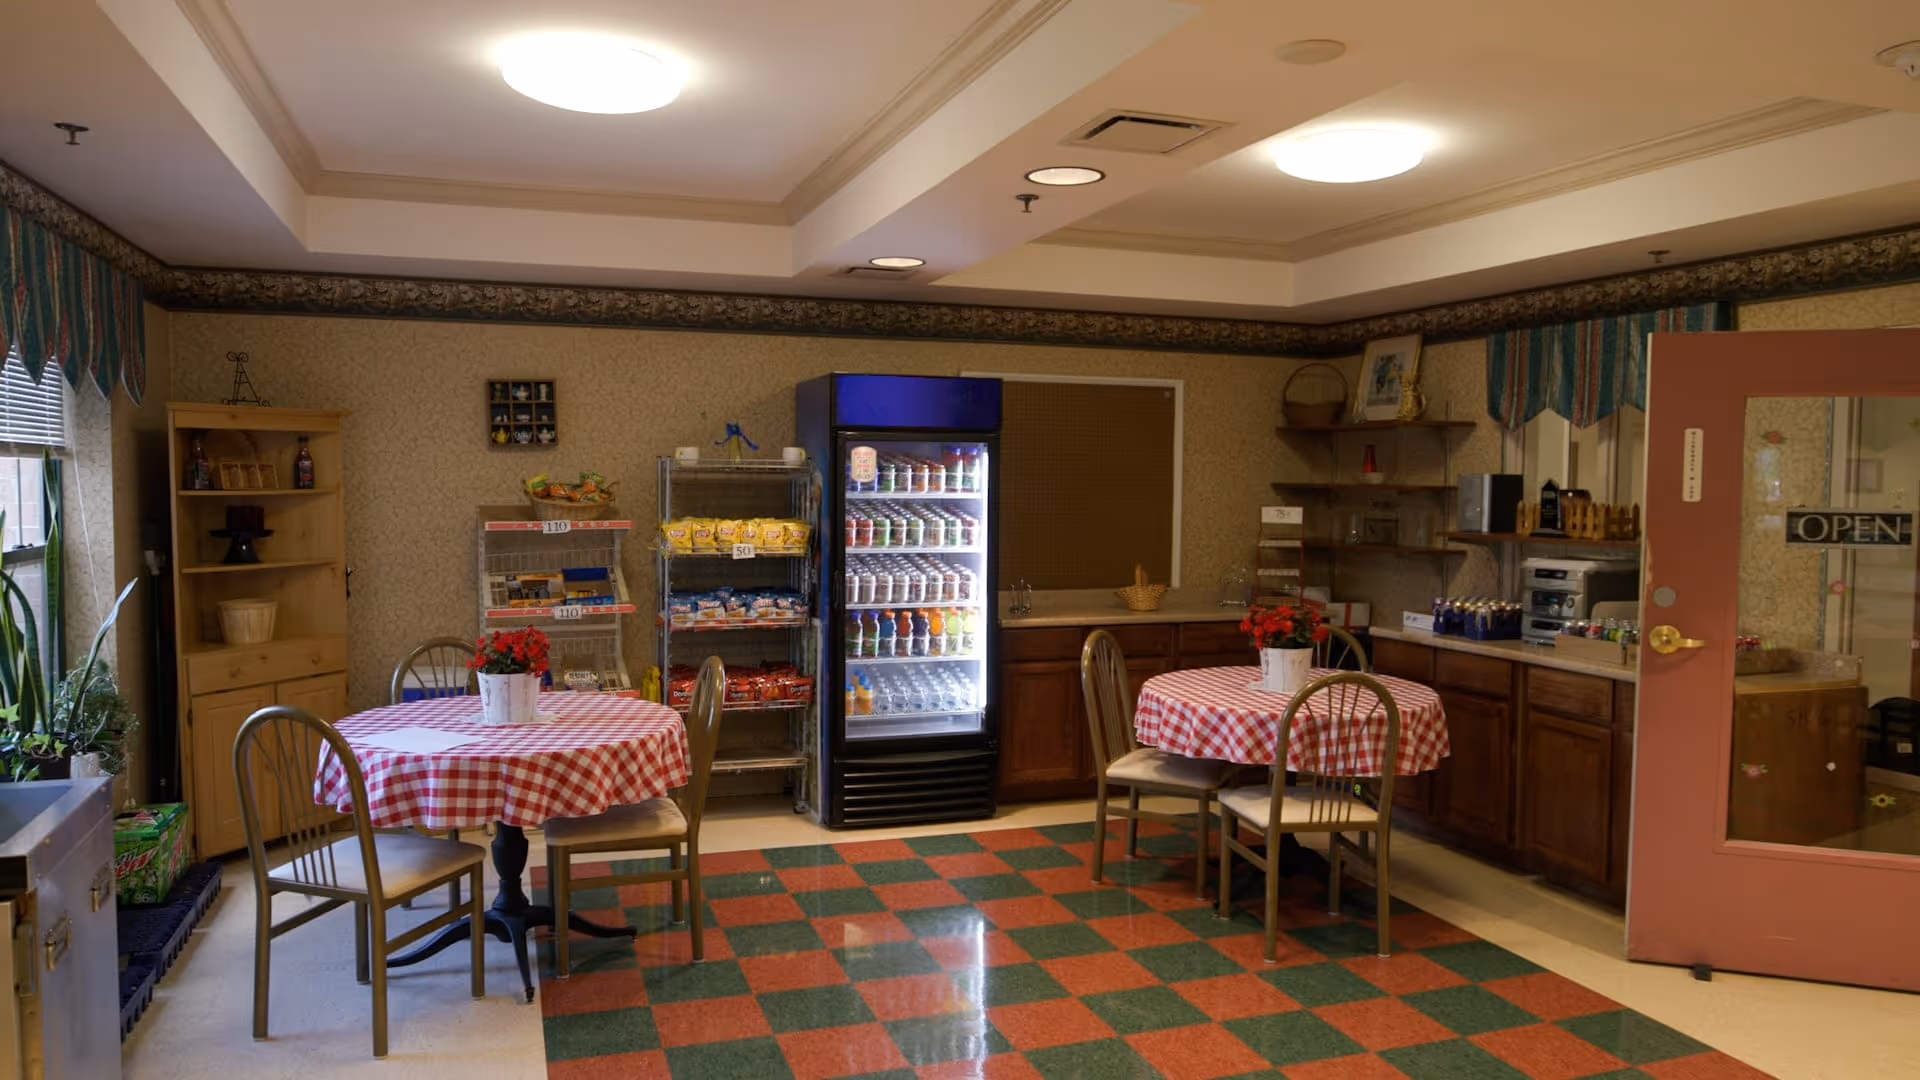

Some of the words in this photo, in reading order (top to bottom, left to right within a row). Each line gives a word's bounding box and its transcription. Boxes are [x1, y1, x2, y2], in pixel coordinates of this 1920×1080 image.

[547, 521, 567, 532] 110
[1798, 514, 1901, 543] OPEN
[736, 546, 751, 557] 50
[559, 608, 579, 618] 110
